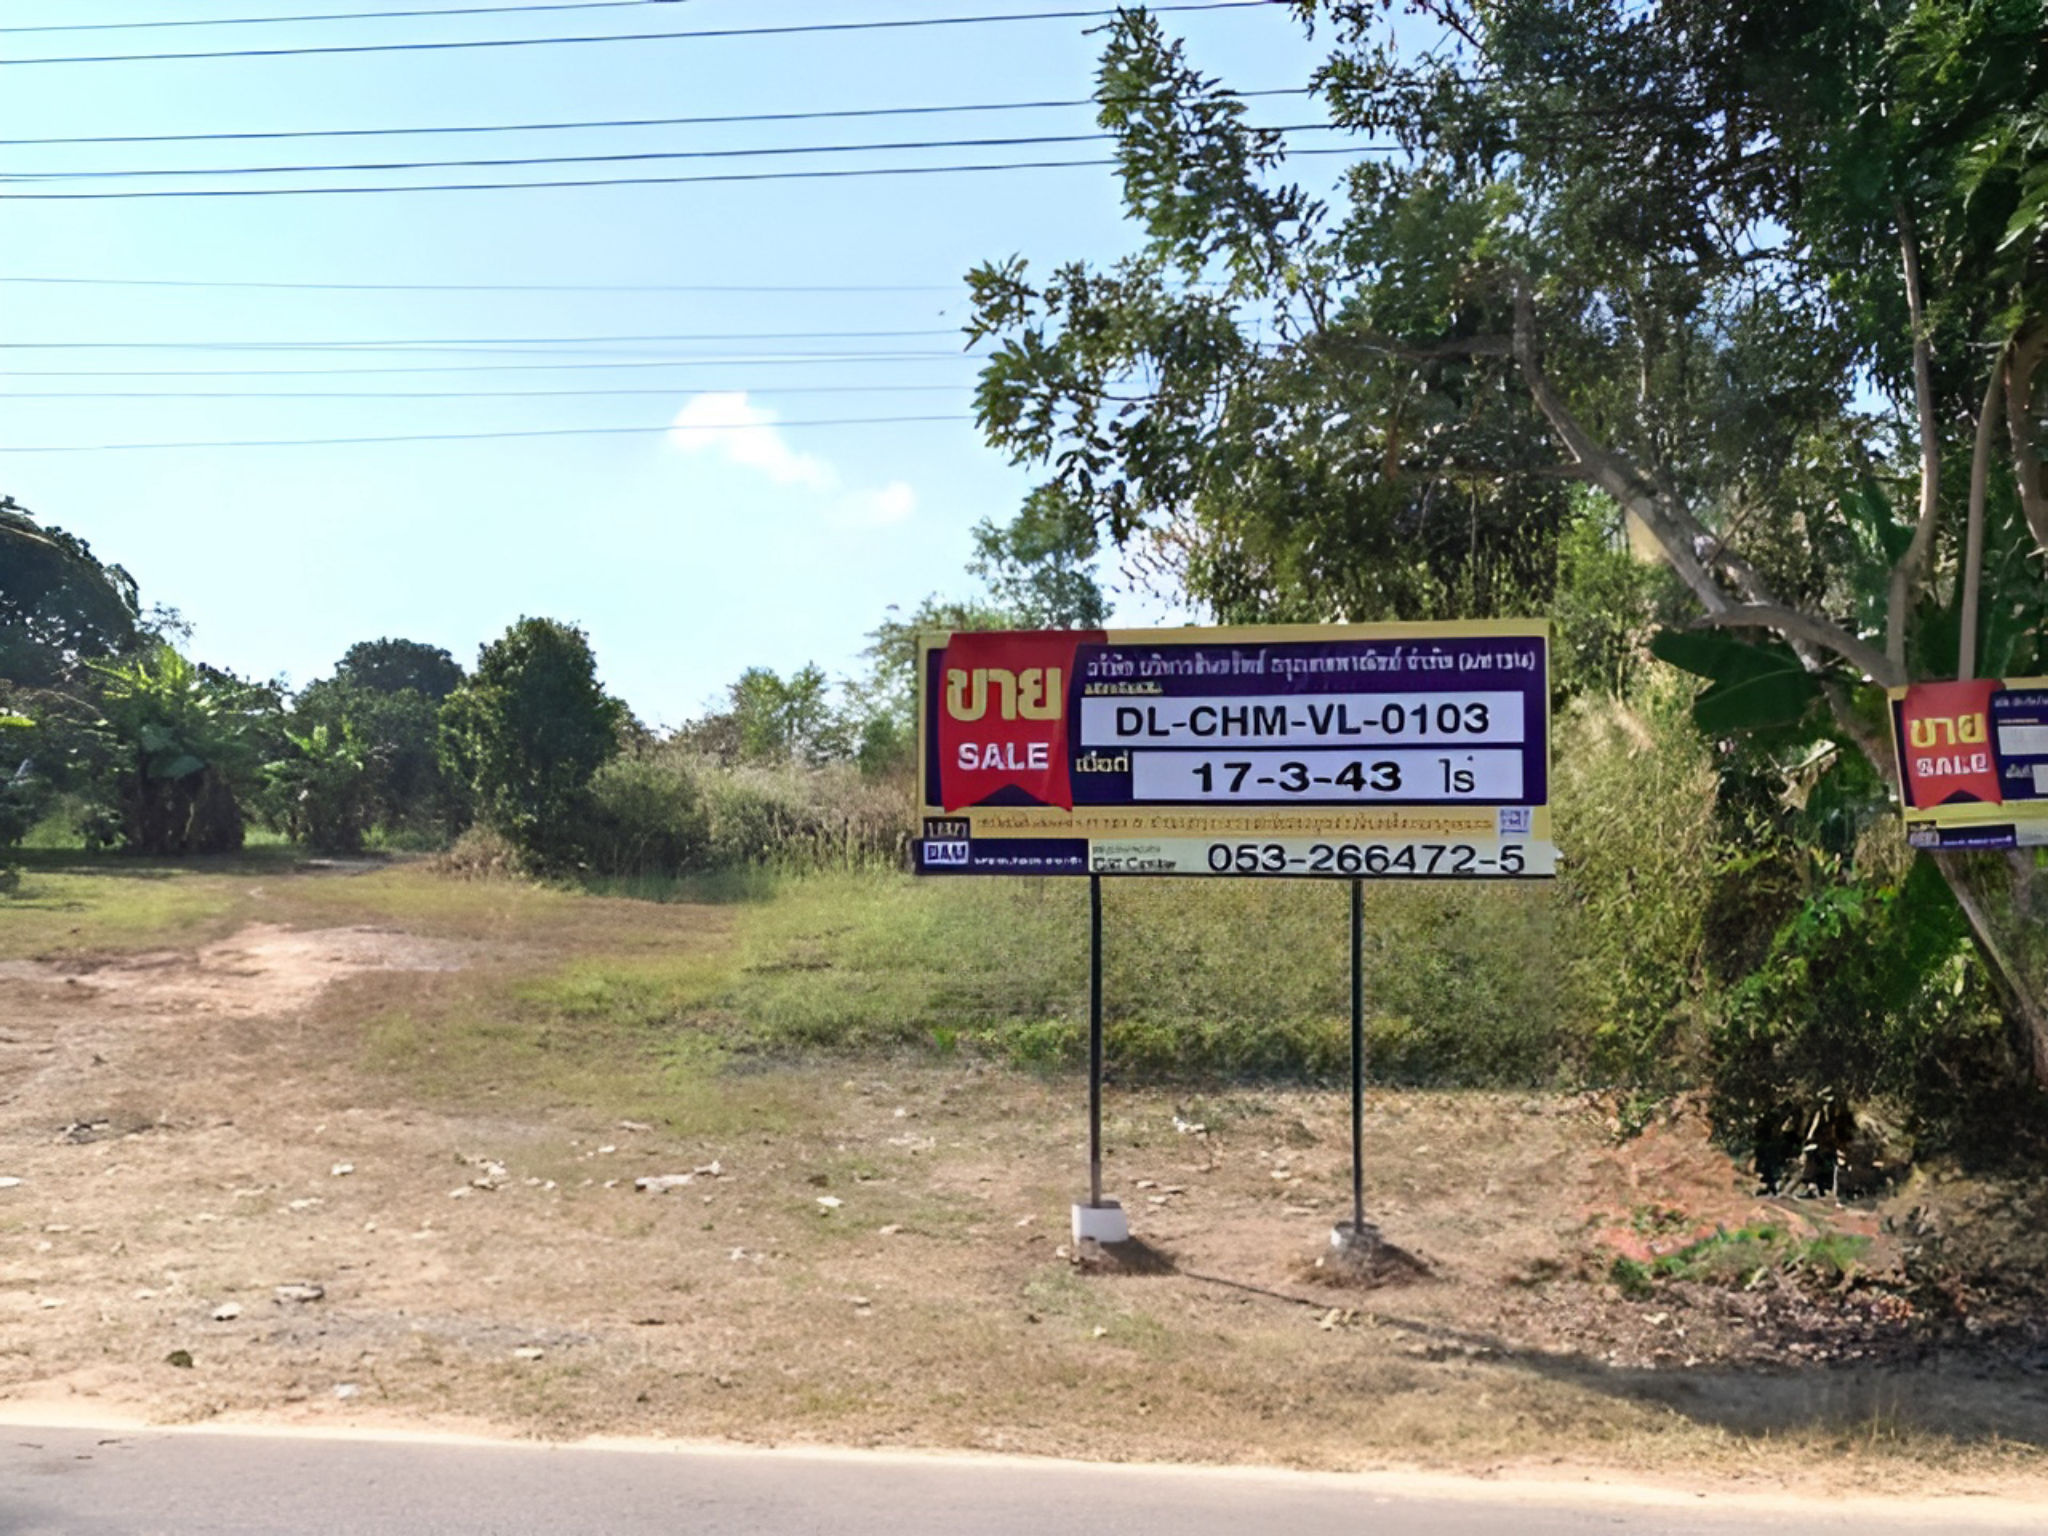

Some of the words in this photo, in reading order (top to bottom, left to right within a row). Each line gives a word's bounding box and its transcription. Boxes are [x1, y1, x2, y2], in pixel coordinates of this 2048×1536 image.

[946, 667, 1062, 721] ขาย
[1115, 702, 1490, 737] DL-CHM-VL-0103
[957, 741, 1050, 771] SALE
[1191, 761, 1403, 793] 17-3-43
[1207, 842, 1526, 875] 053-266472-5
